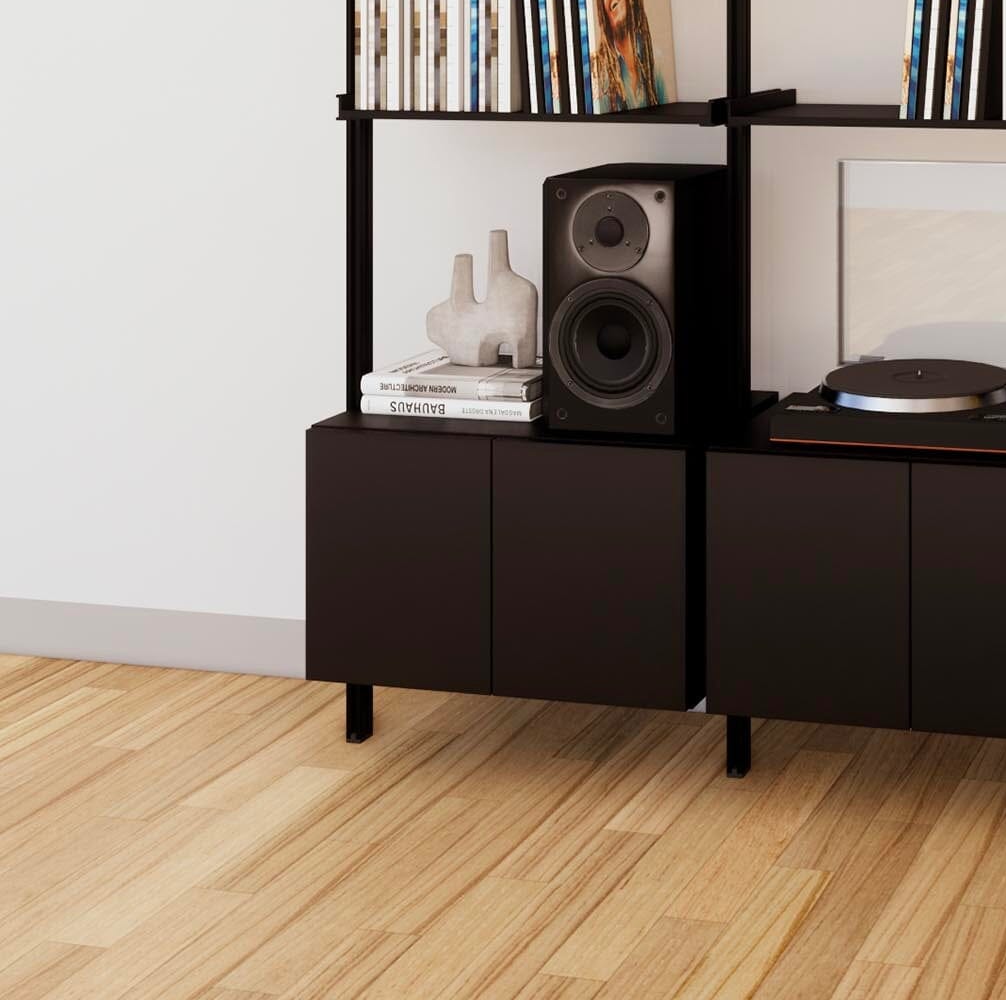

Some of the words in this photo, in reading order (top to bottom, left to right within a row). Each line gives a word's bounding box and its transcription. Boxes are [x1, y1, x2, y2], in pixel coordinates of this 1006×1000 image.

[379, 382, 428, 393] ARCHITECTURE
[428, 384, 457, 394] MODERN
[389, 401, 446, 415] BAUHAUS
[485, 408, 523, 417] MAGDALENA
